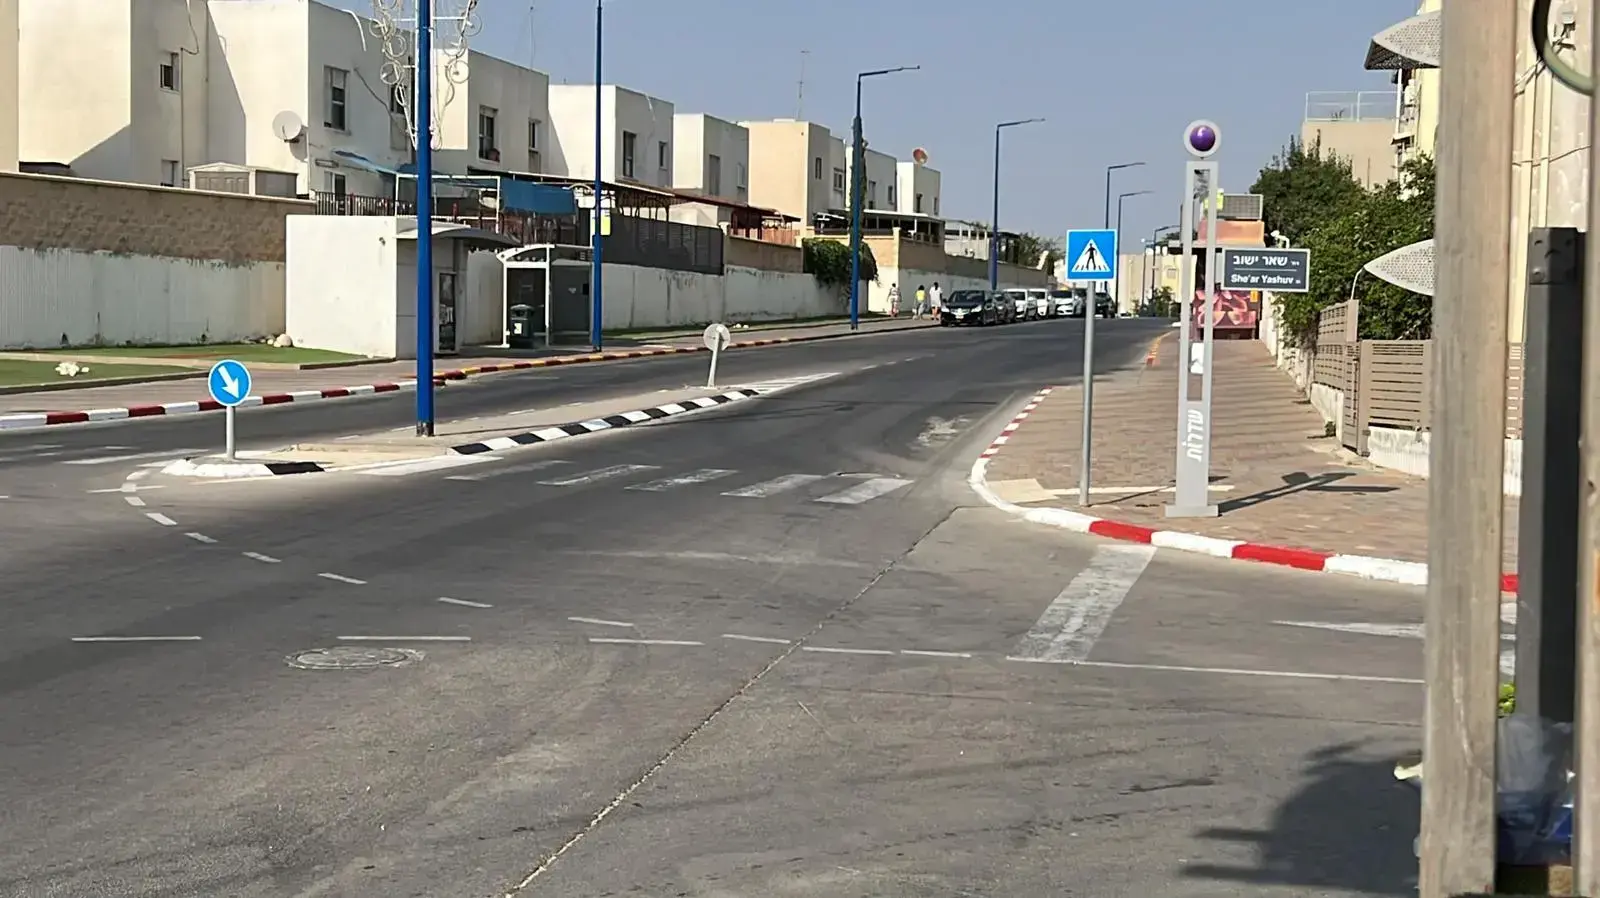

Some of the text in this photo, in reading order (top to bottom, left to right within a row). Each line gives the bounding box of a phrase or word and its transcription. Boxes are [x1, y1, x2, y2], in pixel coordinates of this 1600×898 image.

[1233, 255, 1258, 265] ישוב
[1262, 256, 1288, 266] שאר
[1231, 274, 1260, 283] She'ar
[1261, 275, 1294, 284] Yashuv
